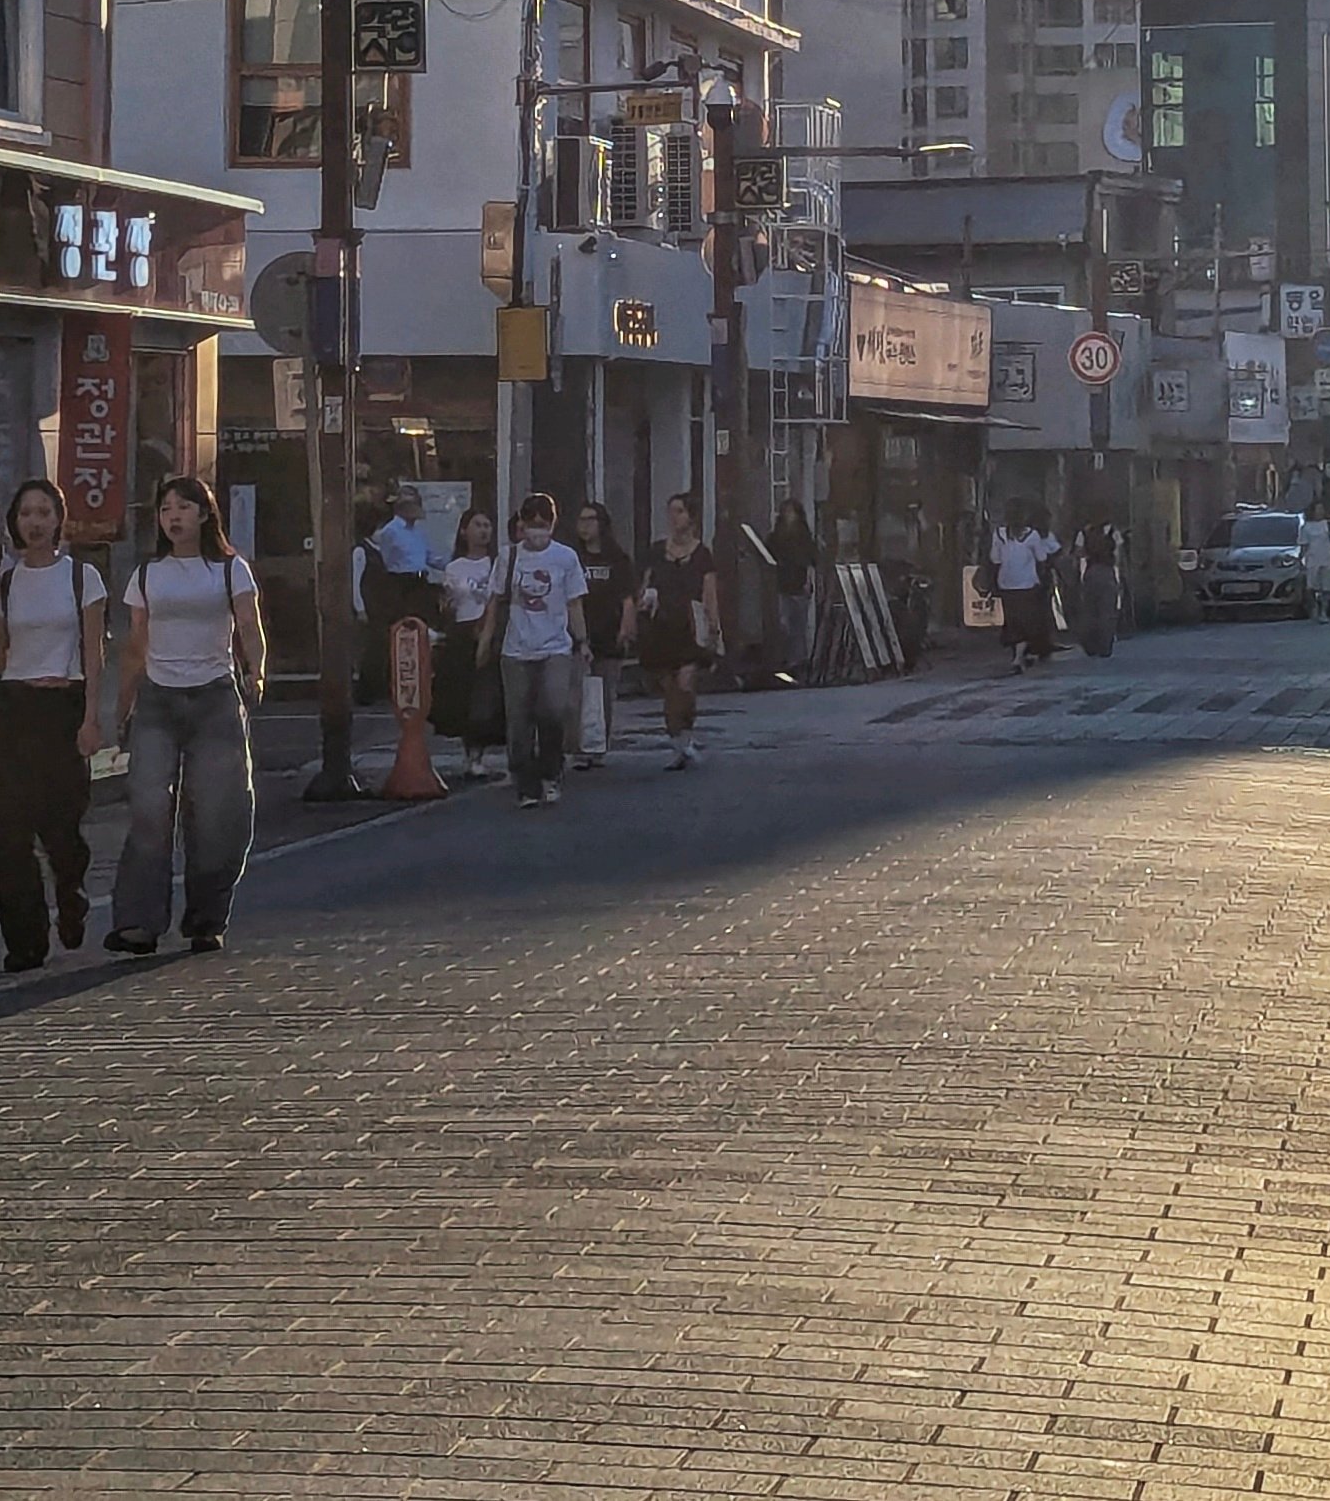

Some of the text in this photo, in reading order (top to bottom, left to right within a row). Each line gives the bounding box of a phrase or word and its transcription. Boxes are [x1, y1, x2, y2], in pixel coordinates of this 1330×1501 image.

[55, 204, 152, 288] 정관장
[1080, 345, 1108, 371] 30
[73, 377, 117, 510] 정관장
